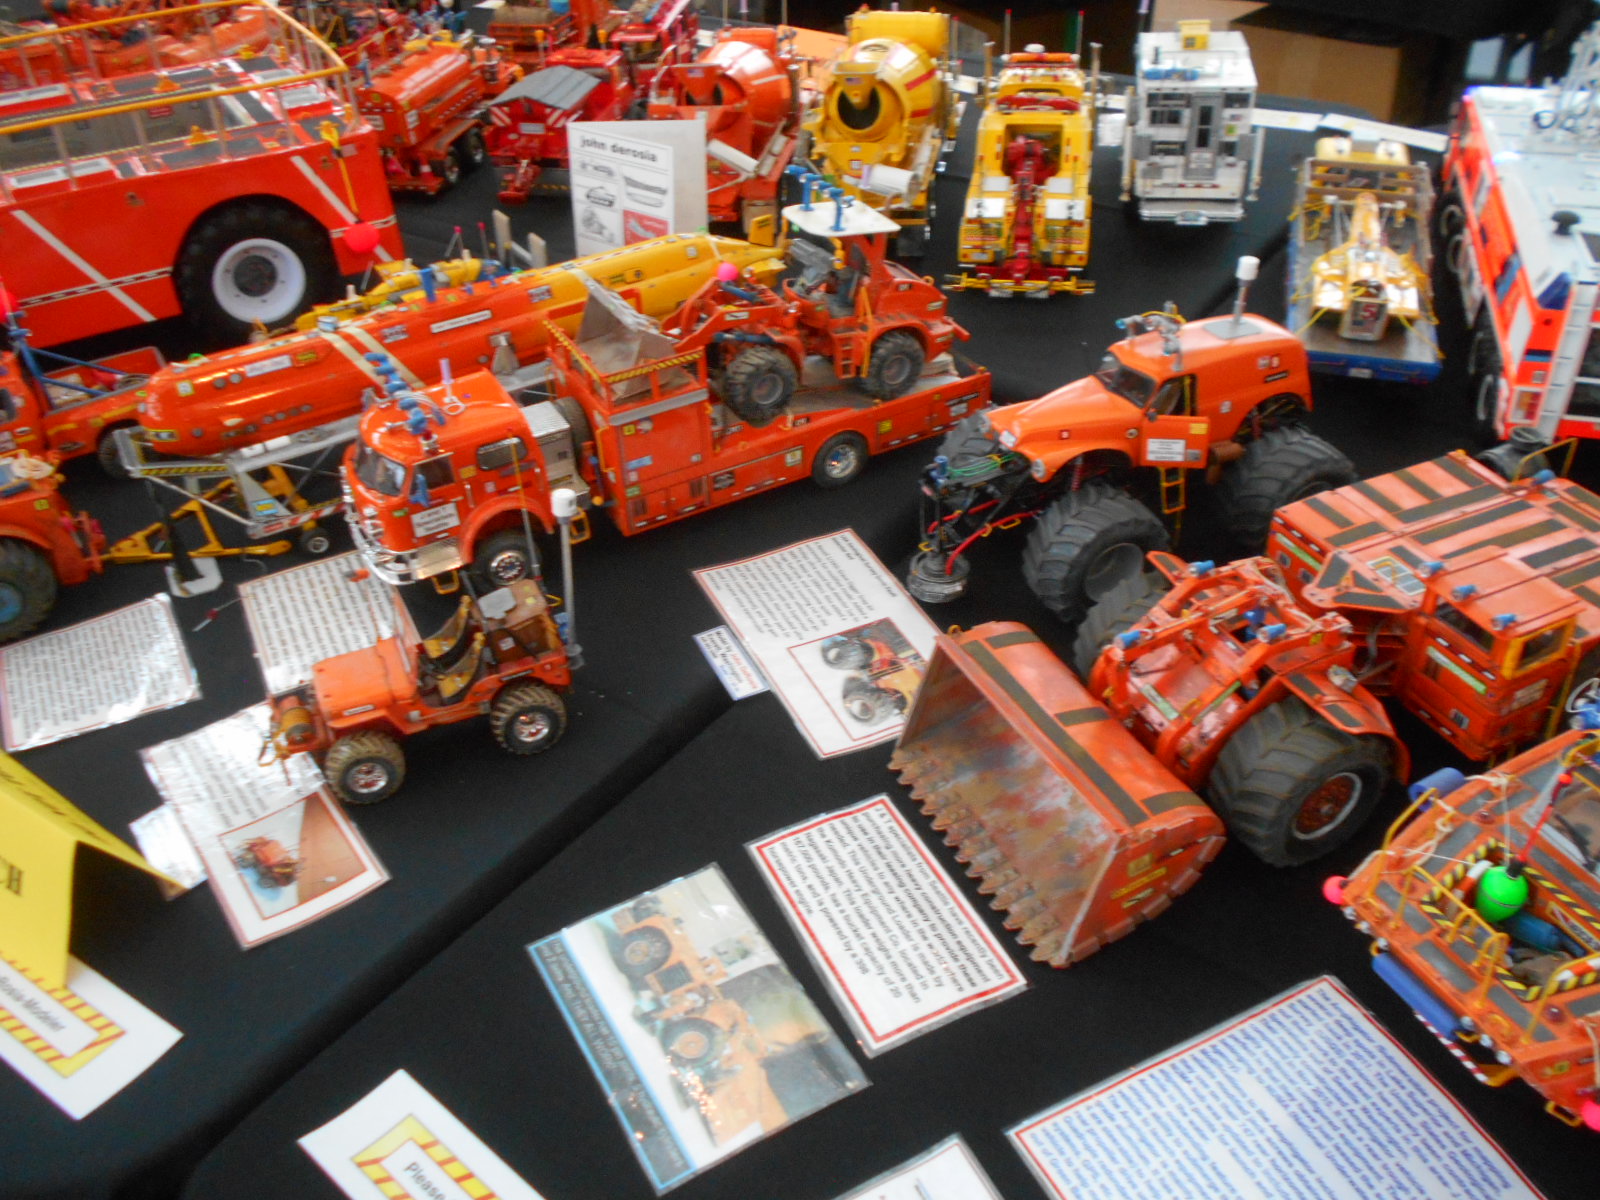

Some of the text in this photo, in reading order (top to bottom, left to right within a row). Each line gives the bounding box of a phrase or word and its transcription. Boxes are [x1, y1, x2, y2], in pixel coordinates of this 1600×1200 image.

[580, 136, 657, 162] john derosia
[768, 847, 797, 888] horsepower
[780, 842, 797, 863] metric
[804, 832, 829, 863] Nagasaki
[843, 889, 856, 905] This
[854, 906, 873, 930] loader
[870, 932, 892, 960] weighs
[890, 961, 907, 982] more
[905, 983, 920, 1003] than
[807, 884, 821, 898] and
[816, 827, 827, 839] the
[824, 839, 847, 869] Komodo
[845, 869, 863, 892] Heavy
[860, 893, 892, 933] Equipment
[899, 950, 923, 980] located
[920, 980, 929, 990] in
[817, 899, 824, 907] is
[819, 907, 847, 940] powered
[839, 819, 859, 841] unique
[857, 843, 879, 871] vehicles
[877, 872, 885, 880] to
[883, 881, 896, 894] any
[894, 896, 913, 919] where
[910, 919, 919, 927] in
[917, 928, 929, 941] the
[944, 967, 964, 992] where
[848, 850, 861, 866] This
[859, 866, 896, 914] Underground
[892, 915, 914, 942] Loader
[911, 943, 920, 952] is
[918, 953, 936, 975] made
[933, 976, 944, 987] by
[851, 815, 977, 987] to use in their leasing company to provide these
[862, 812, 990, 982] purchasing more heavy construction equipment
[888, 826, 917, 861] specialists
[916, 862, 930, 879] from
[929, 880, 950, 905] Seattle
[948, 907, 964, 925] have
[962, 927, 987, 958] recently
[986, 959, 1003, 979] been
[830, 893, 842, 908] has
[843, 914, 864, 940] bucket
[860, 942, 886, 976] capacity
[883, 977, 895, 986] of
[843, 940, 853, 952] by
[404, 1161, 445, 1200] Please
